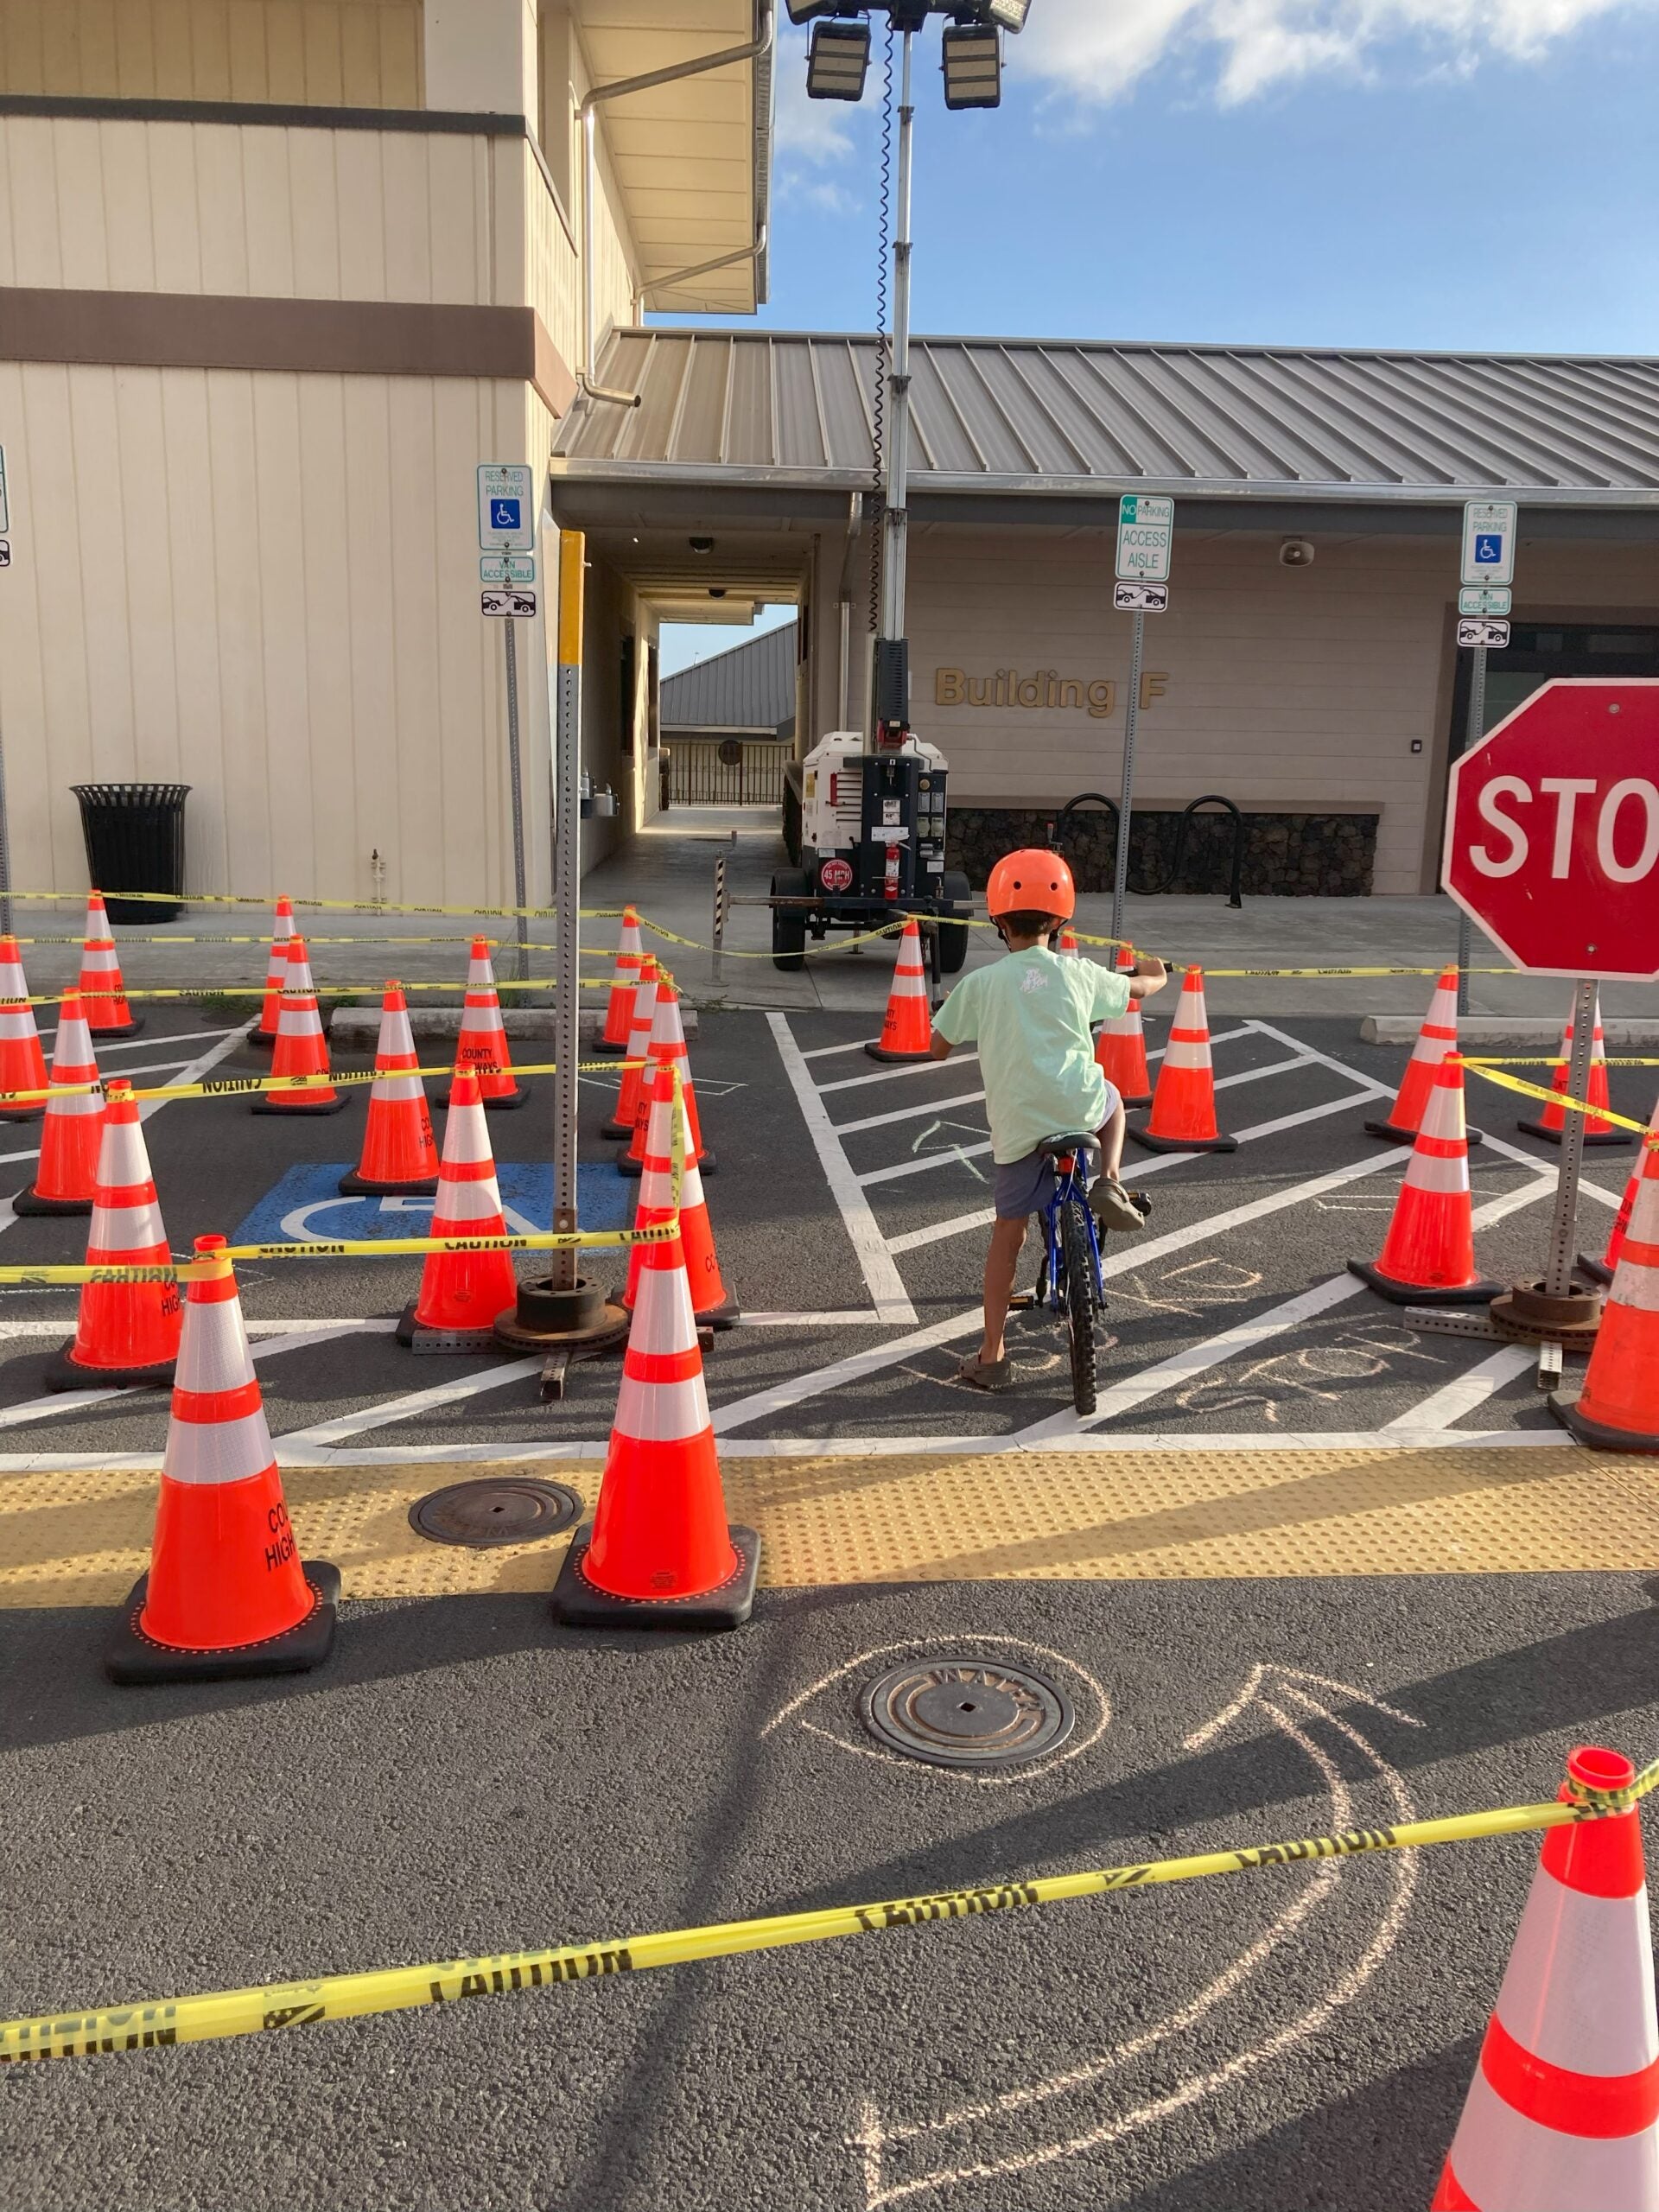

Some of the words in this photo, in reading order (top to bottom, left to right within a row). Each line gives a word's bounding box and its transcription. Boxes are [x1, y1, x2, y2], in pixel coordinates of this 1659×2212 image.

[485, 470, 524, 482] RESERVED
[486, 485, 524, 497] PARKING
[1122, 505, 1136, 516] NO
[1138, 505, 1170, 518] PARKING
[1472, 507, 1508, 518] RESERVED
[1472, 521, 1508, 532] PARKING
[1122, 530, 1167, 548] ACCESS
[499, 561, 516, 569] VAN
[1128, 552, 1160, 569] AISLE
[483, 569, 532, 578] ACCESSIBLE
[1462, 601, 1508, 610] ACCESSIBLE
[934, 667, 1116, 718] Building
[1139, 671, 1169, 709] F
[1469, 774, 1659, 884] STO
[823, 869, 833, 880] 45
[875, 922, 903, 937] CAUTION
[461, 1048, 493, 1059] COUNTY
[1235, 1827, 1397, 1868] CAUTION
[853, 1881, 1039, 1931] CAUTION
